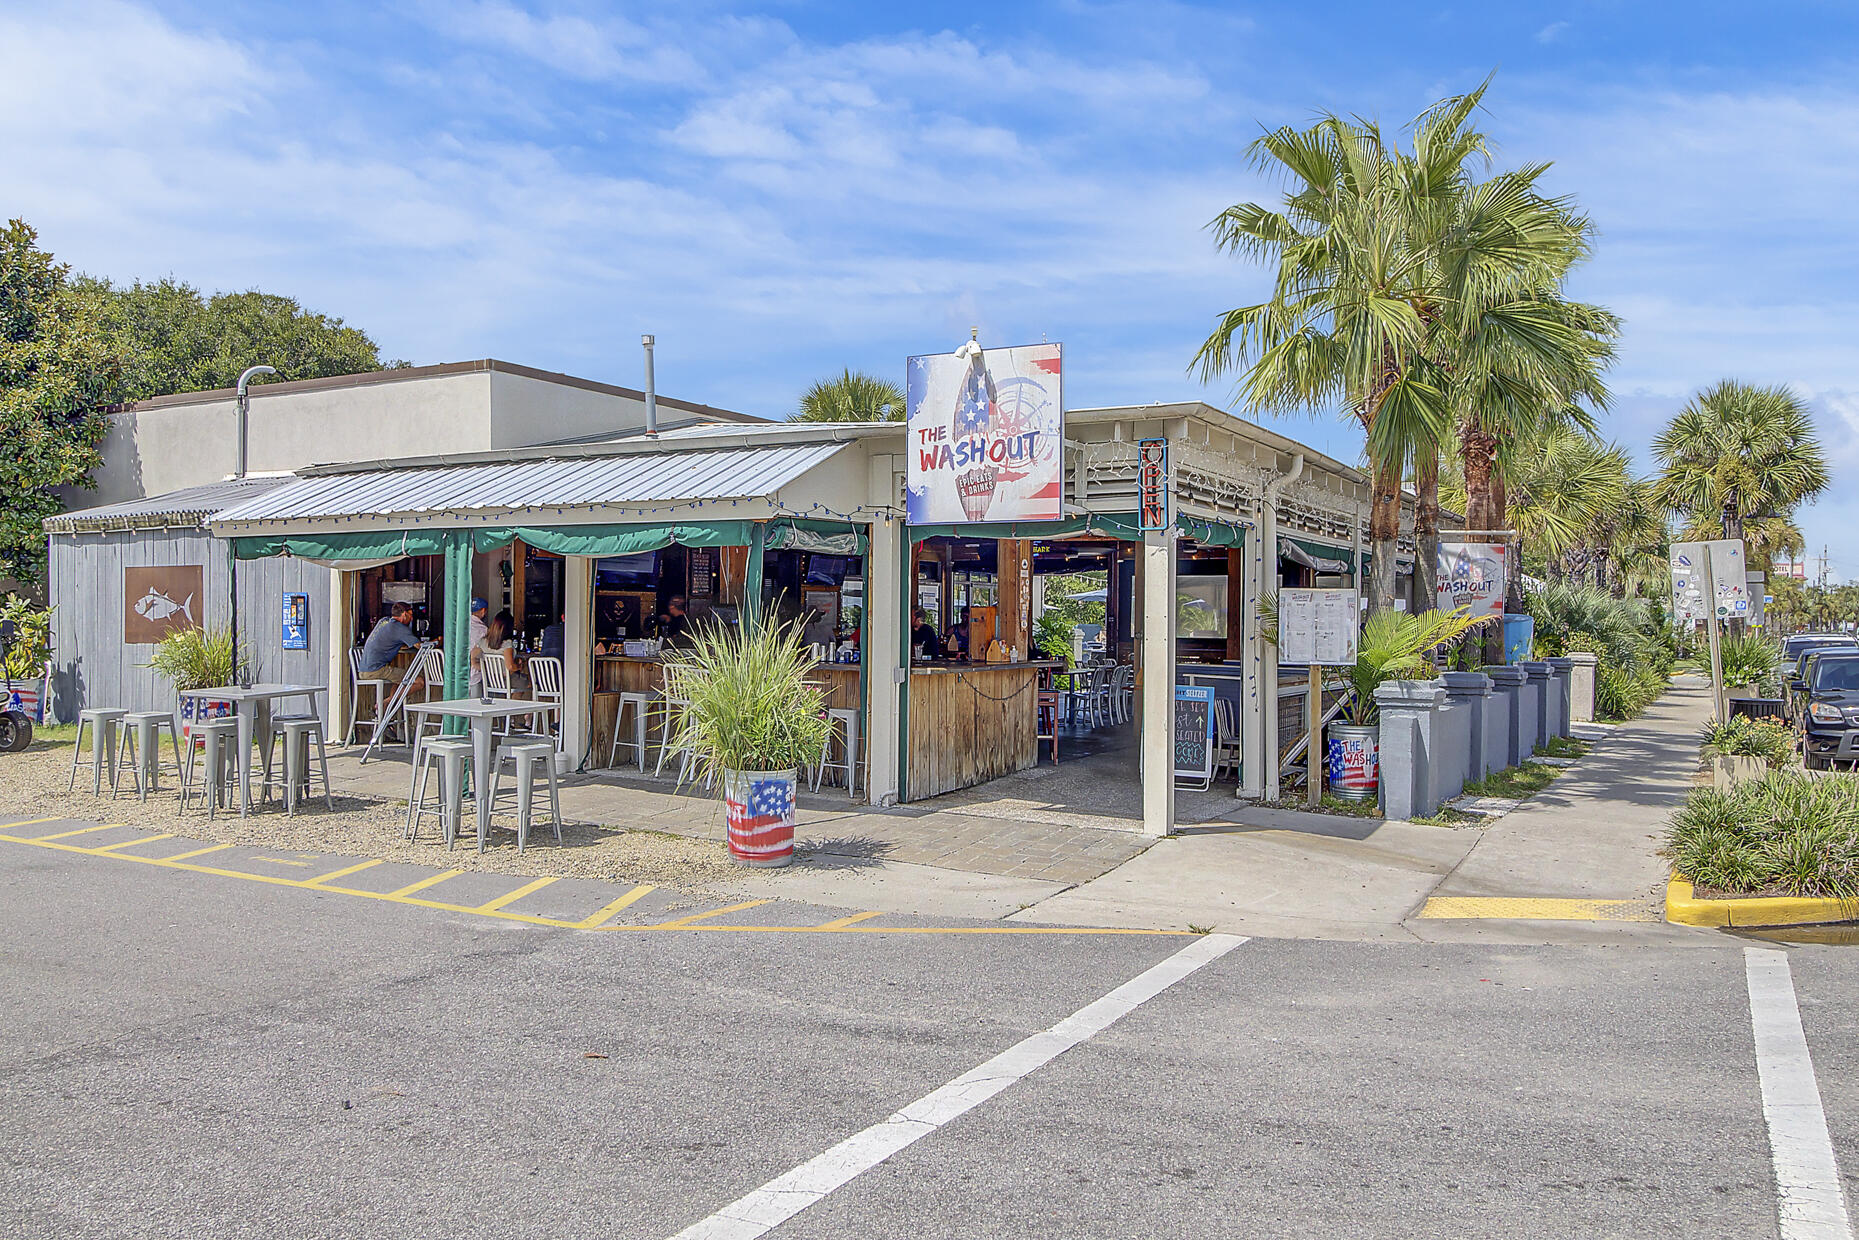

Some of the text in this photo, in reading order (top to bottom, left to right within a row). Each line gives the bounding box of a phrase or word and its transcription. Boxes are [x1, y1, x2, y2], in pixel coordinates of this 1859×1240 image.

[918, 425, 947, 445] THE
[919, 430, 1041, 472] WASHOUT
[959, 472, 993, 488] EPIC EATS
[1142, 442, 1162, 527] OPEN
[961, 481, 994, 497] & DRINKS
[1436, 580, 1494, 594] WASHOUT
[1186, 689, 1208, 698] SELTZER
[1341, 740, 1361, 752] THE
